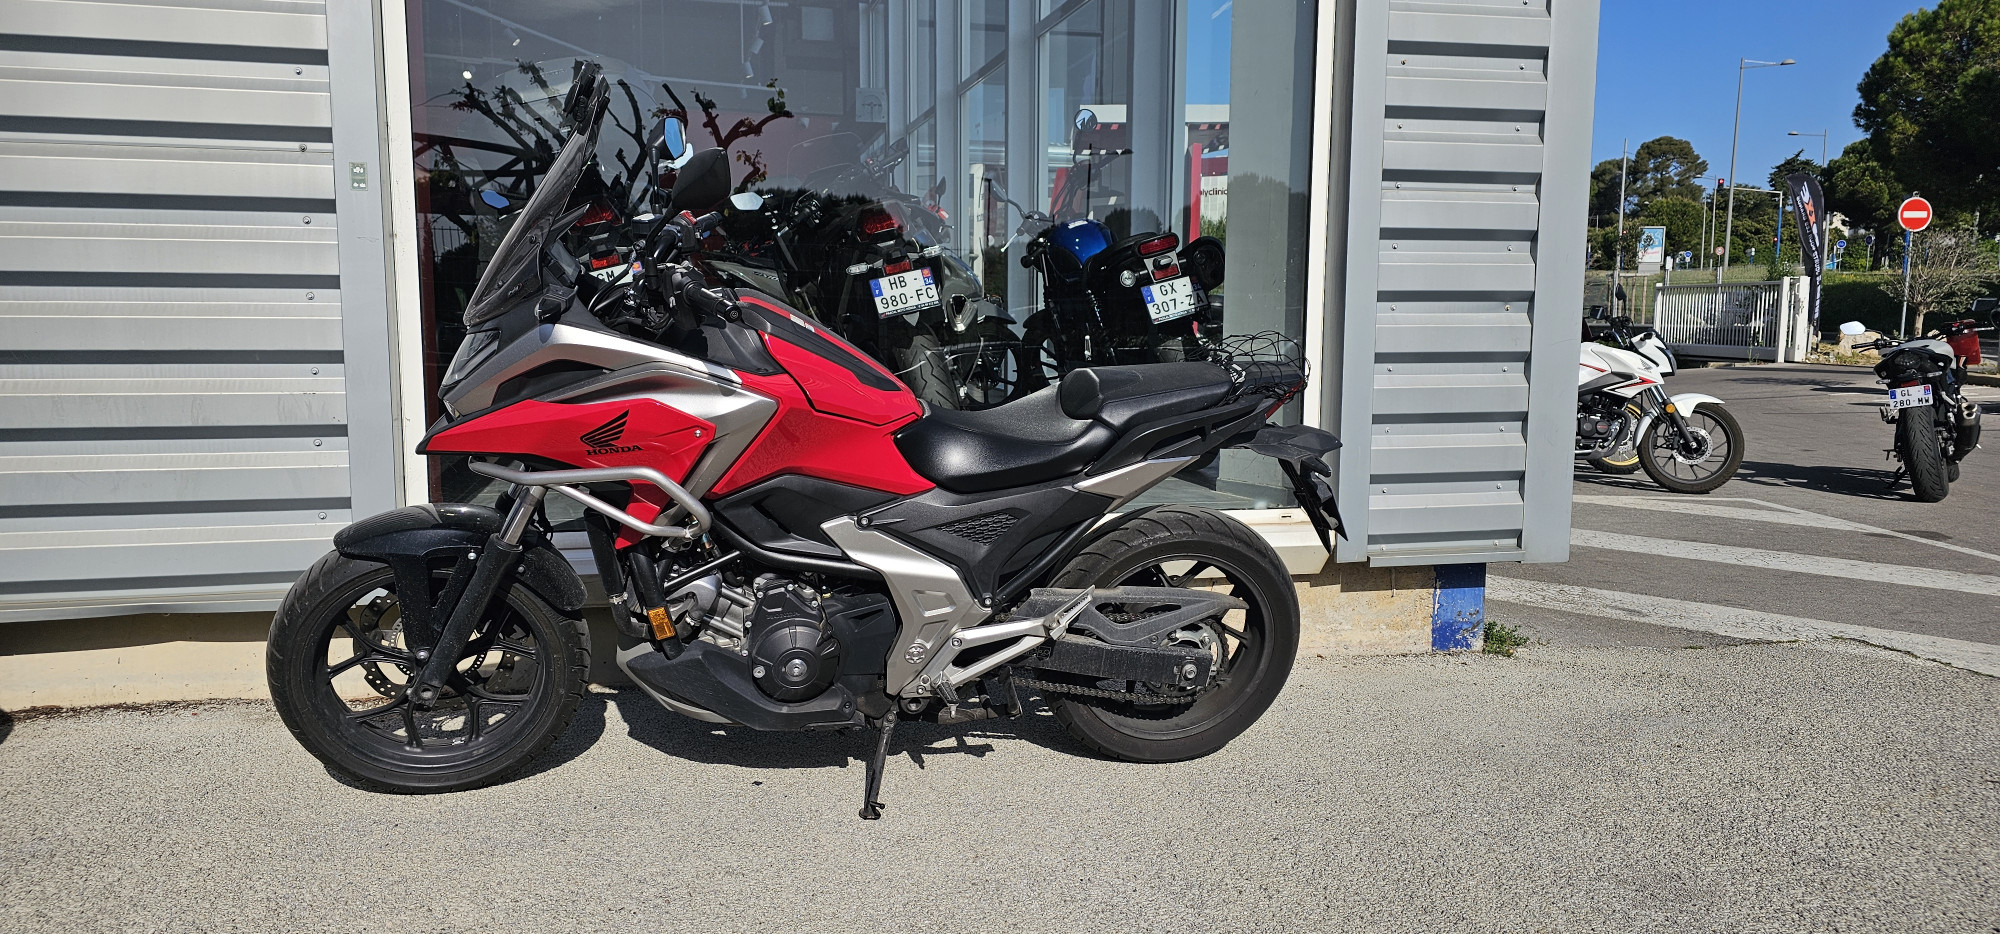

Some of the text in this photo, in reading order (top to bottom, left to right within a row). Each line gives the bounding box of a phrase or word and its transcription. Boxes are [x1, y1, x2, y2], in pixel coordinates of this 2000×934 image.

[888, 275, 907, 290] HB
[1159, 282, 1177, 296] GX
[880, 287, 935, 309] 980-FC
[1152, 292, 1205, 315] 307-ZA
[1900, 389, 1913, 397] GL
[585, 444, 644, 456] HONDA
